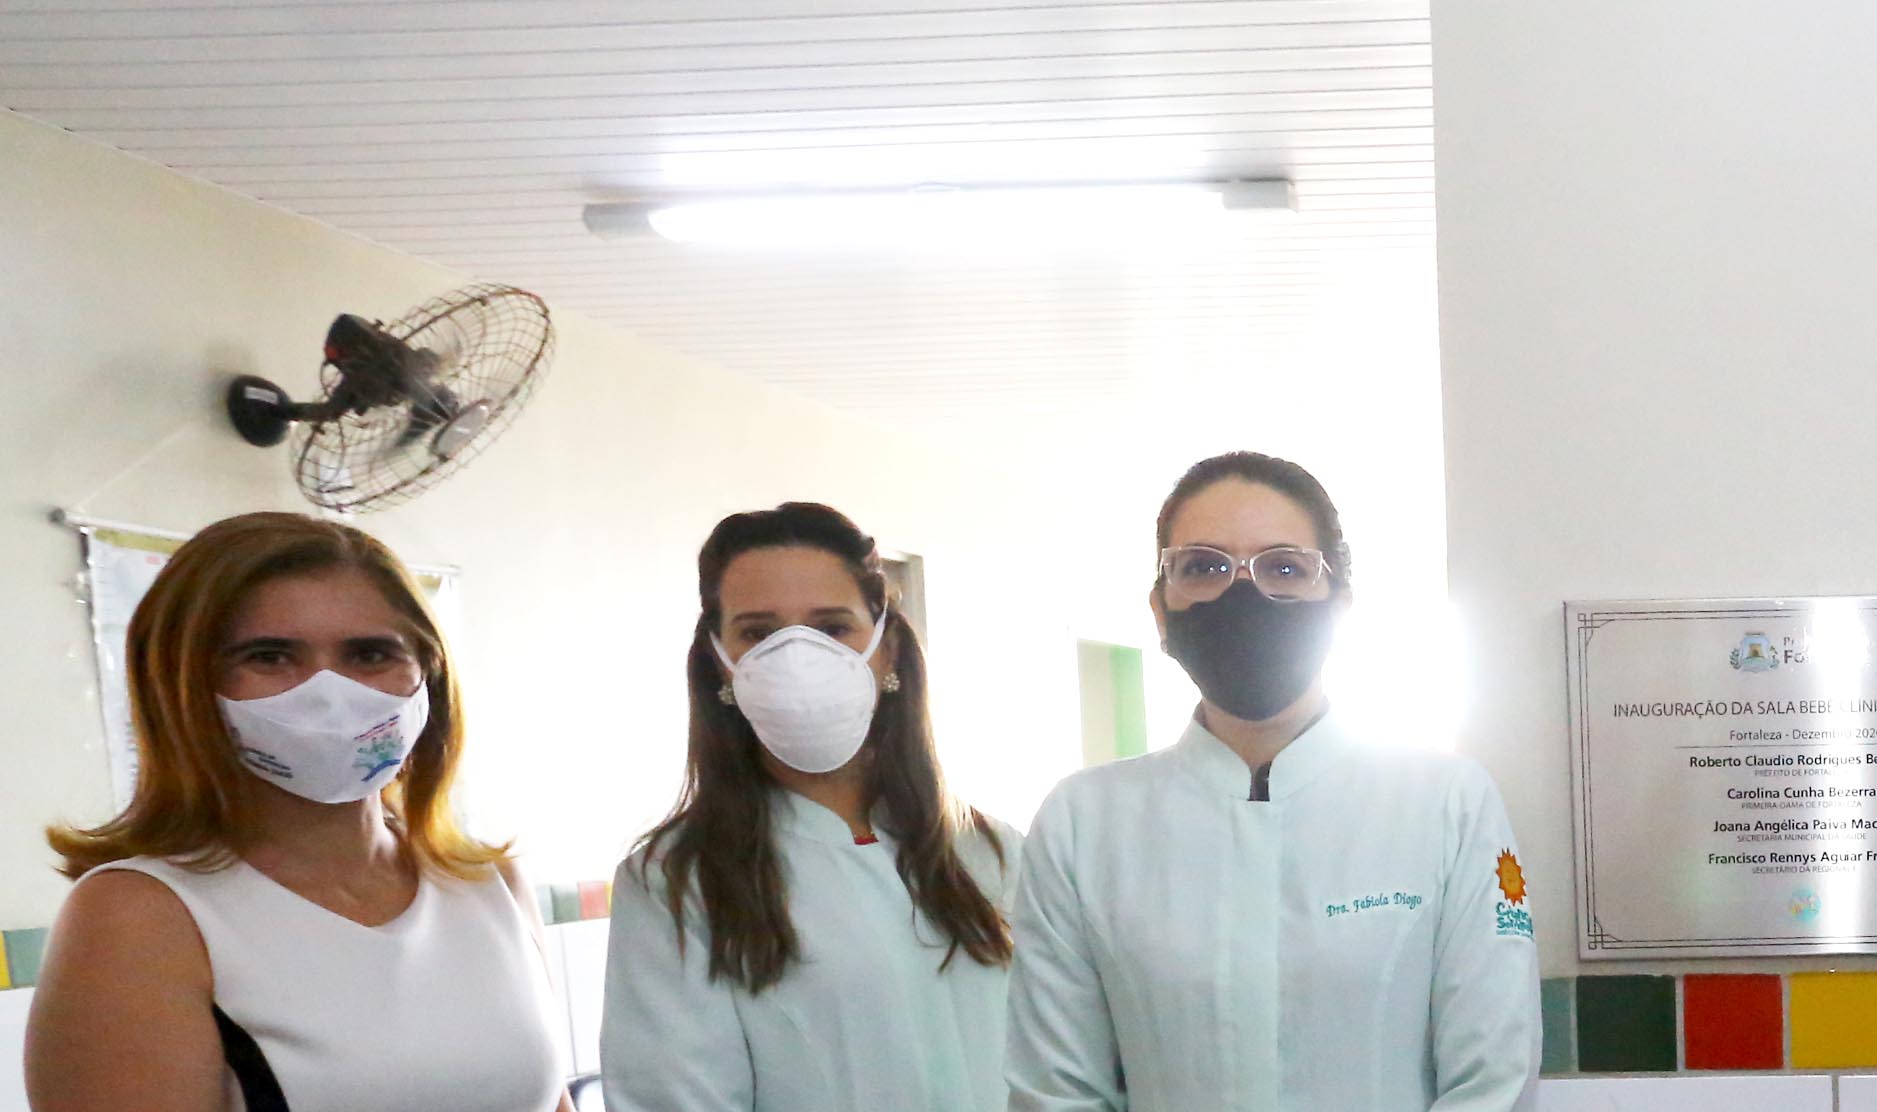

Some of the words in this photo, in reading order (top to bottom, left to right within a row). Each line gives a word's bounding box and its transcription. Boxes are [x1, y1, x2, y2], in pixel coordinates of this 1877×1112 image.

[1613, 700, 1728, 719] INAUGURAÇÃO
[1731, 701, 1754, 716] DA
[1757, 700, 1796, 715] SALA
[1729, 730, 1782, 741] Fortaleza
[1690, 755, 1741, 768] Roberto
[1745, 754, 1794, 767] Claudio
[1797, 753, 1862, 768] Rodrigues
[1727, 787, 1780, 800] Carolina
[1783, 786, 1824, 799] Cunha
[1829, 786, 1877, 798] Bezerra
[1713, 820, 1750, 833] Joana
[1754, 819, 1809, 834] Angélica
[1812, 818, 1847, 831] Paiva
[1708, 853, 1766, 865] Francisco
[1770, 852, 1817, 866] Rennys
[1820, 851, 1863, 865] Aguiar
[1326, 904, 1349, 917] Dra.
